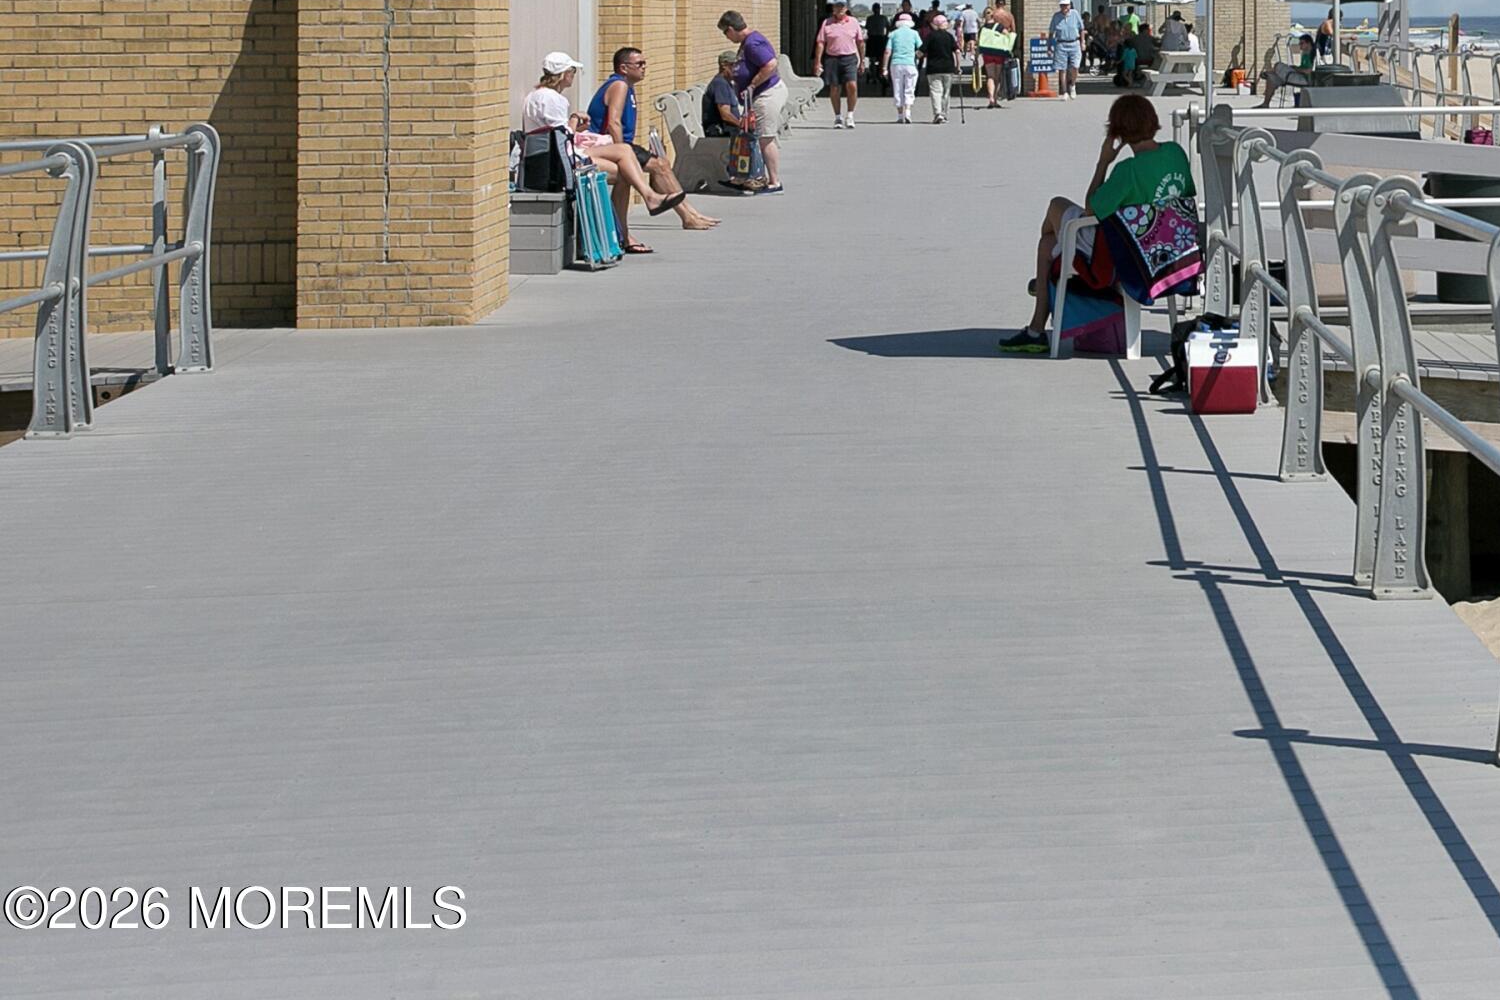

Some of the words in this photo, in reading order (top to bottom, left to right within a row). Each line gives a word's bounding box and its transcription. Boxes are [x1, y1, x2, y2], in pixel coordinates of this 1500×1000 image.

[1249, 281, 1260, 338] SPRIN
[1298, 328, 1311, 405] SPRING
[1297, 417, 1310, 468] LAKE
[1394, 402, 1408, 499] SPRING
[1394, 516, 1408, 580] LAKE
